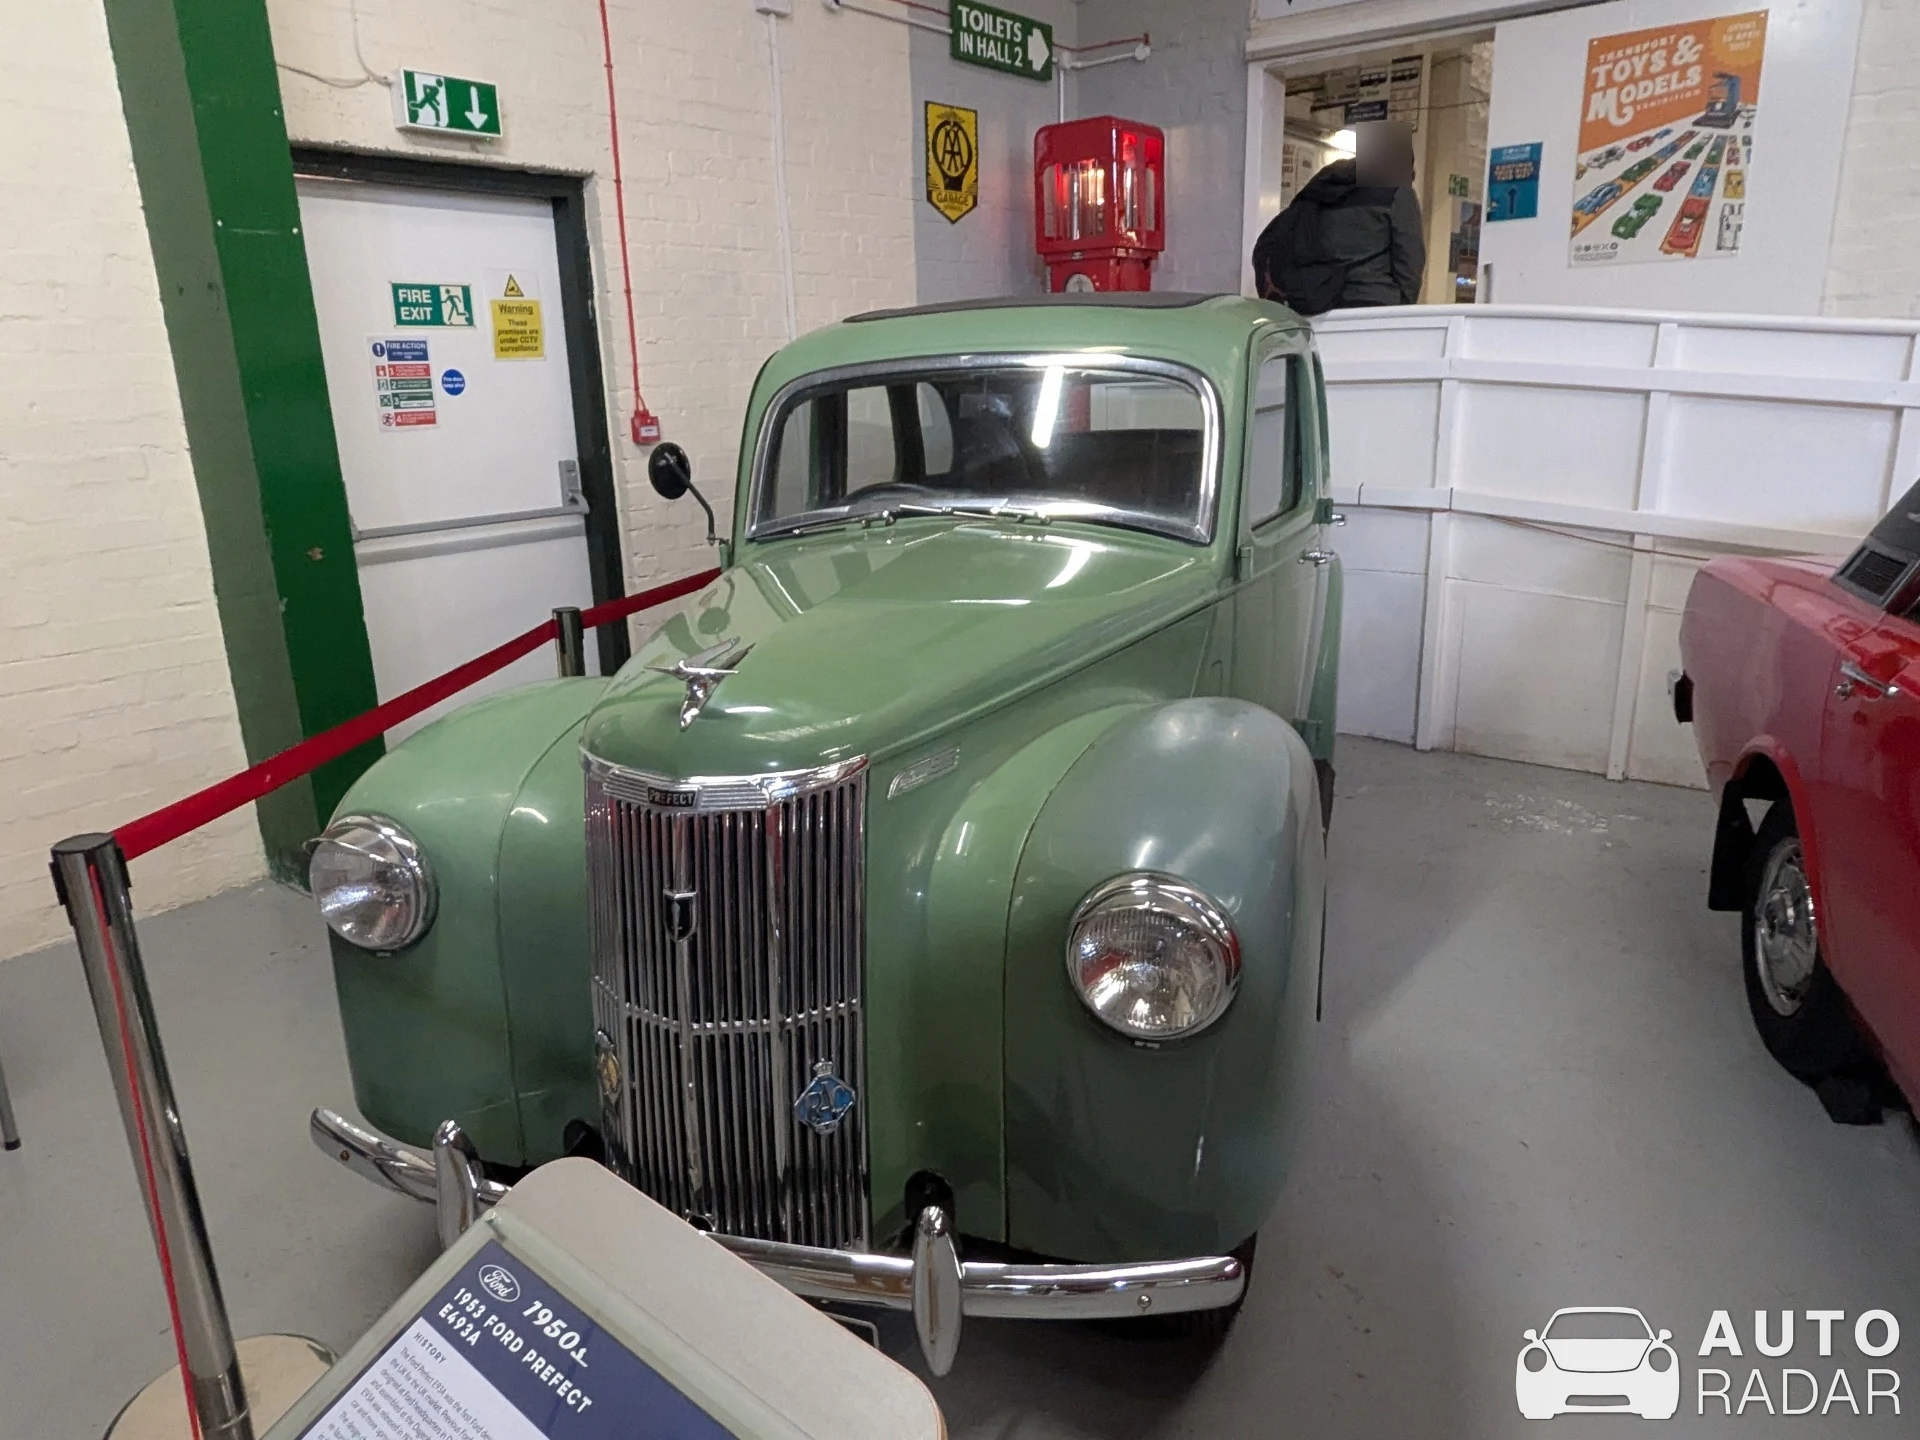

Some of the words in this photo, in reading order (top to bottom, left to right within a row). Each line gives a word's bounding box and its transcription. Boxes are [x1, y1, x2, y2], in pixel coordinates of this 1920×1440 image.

[958, 5, 1022, 42] TOILETS
[960, 31, 973, 54] IN
[977, 36, 1012, 64] HALL
[1014, 46, 1023, 67] 2
[1591, 48, 1667, 88] TOYS
[1672, 34, 1704, 66] &
[1599, 34, 1677, 63] TRANSPORT
[398, 289, 432, 303] FIRE
[498, 304, 534, 316] Warning
[400, 307, 433, 321] EXIT
[519, 336, 538, 344] CCTV
[650, 790, 694, 804] PREFECT
[483, 1269, 514, 1297] Ford
[439, 1303, 481, 1346] E493A
[522, 1300, 589, 1368] 1950s
[413, 1332, 447, 1364] HISTORY
[454, 1288, 486, 1318] 1953
[483, 1314, 524, 1352] FORD
[522, 1349, 592, 1412] PREFECT
